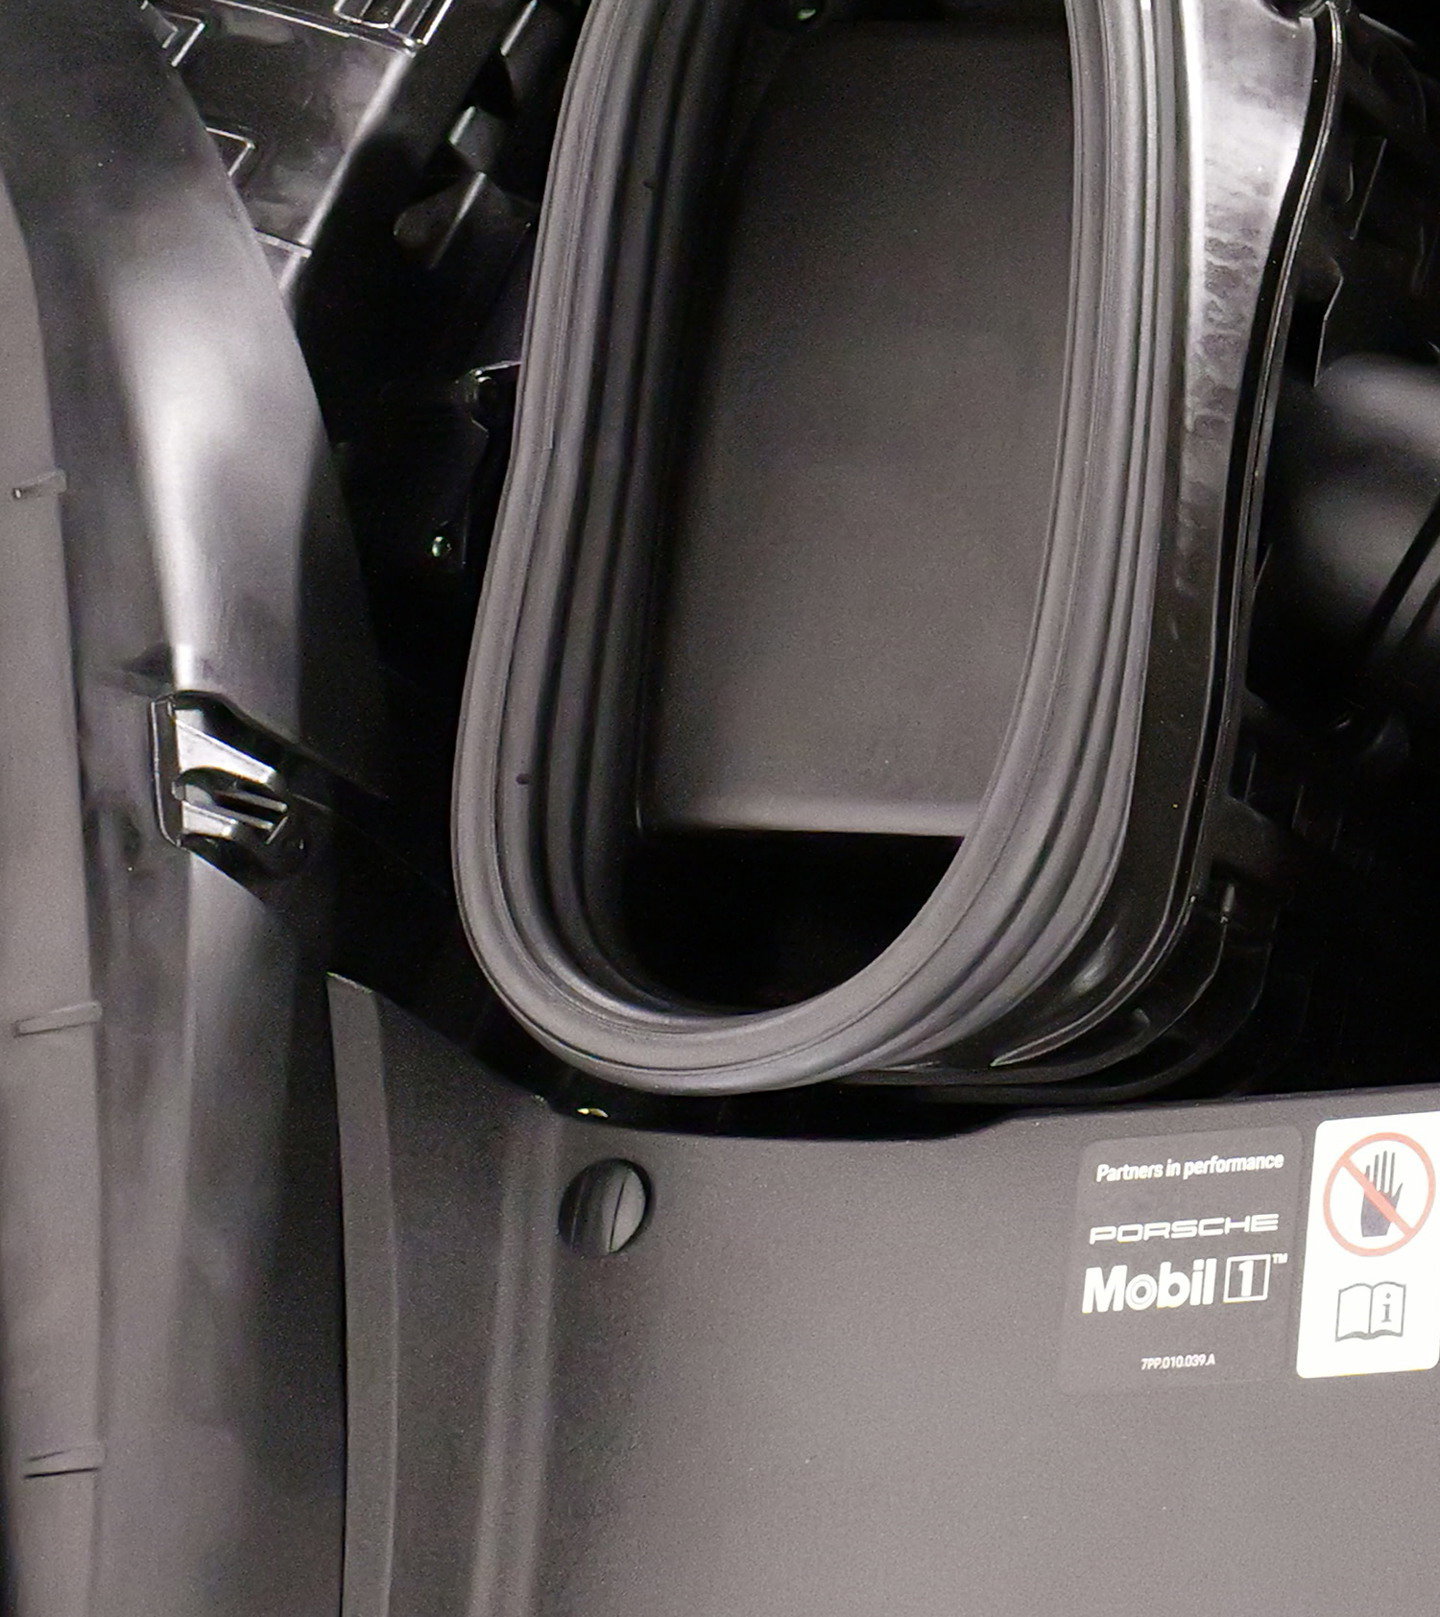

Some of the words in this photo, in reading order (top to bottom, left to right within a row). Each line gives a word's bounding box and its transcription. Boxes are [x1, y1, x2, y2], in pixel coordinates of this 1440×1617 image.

[1097, 1161, 1164, 1183] Partners
[1165, 1158, 1181, 1177] in
[1184, 1154, 1284, 1180] performance
[1089, 1214, 1279, 1244] PORSCHE
[1082, 1258, 1218, 1314] Mobil
